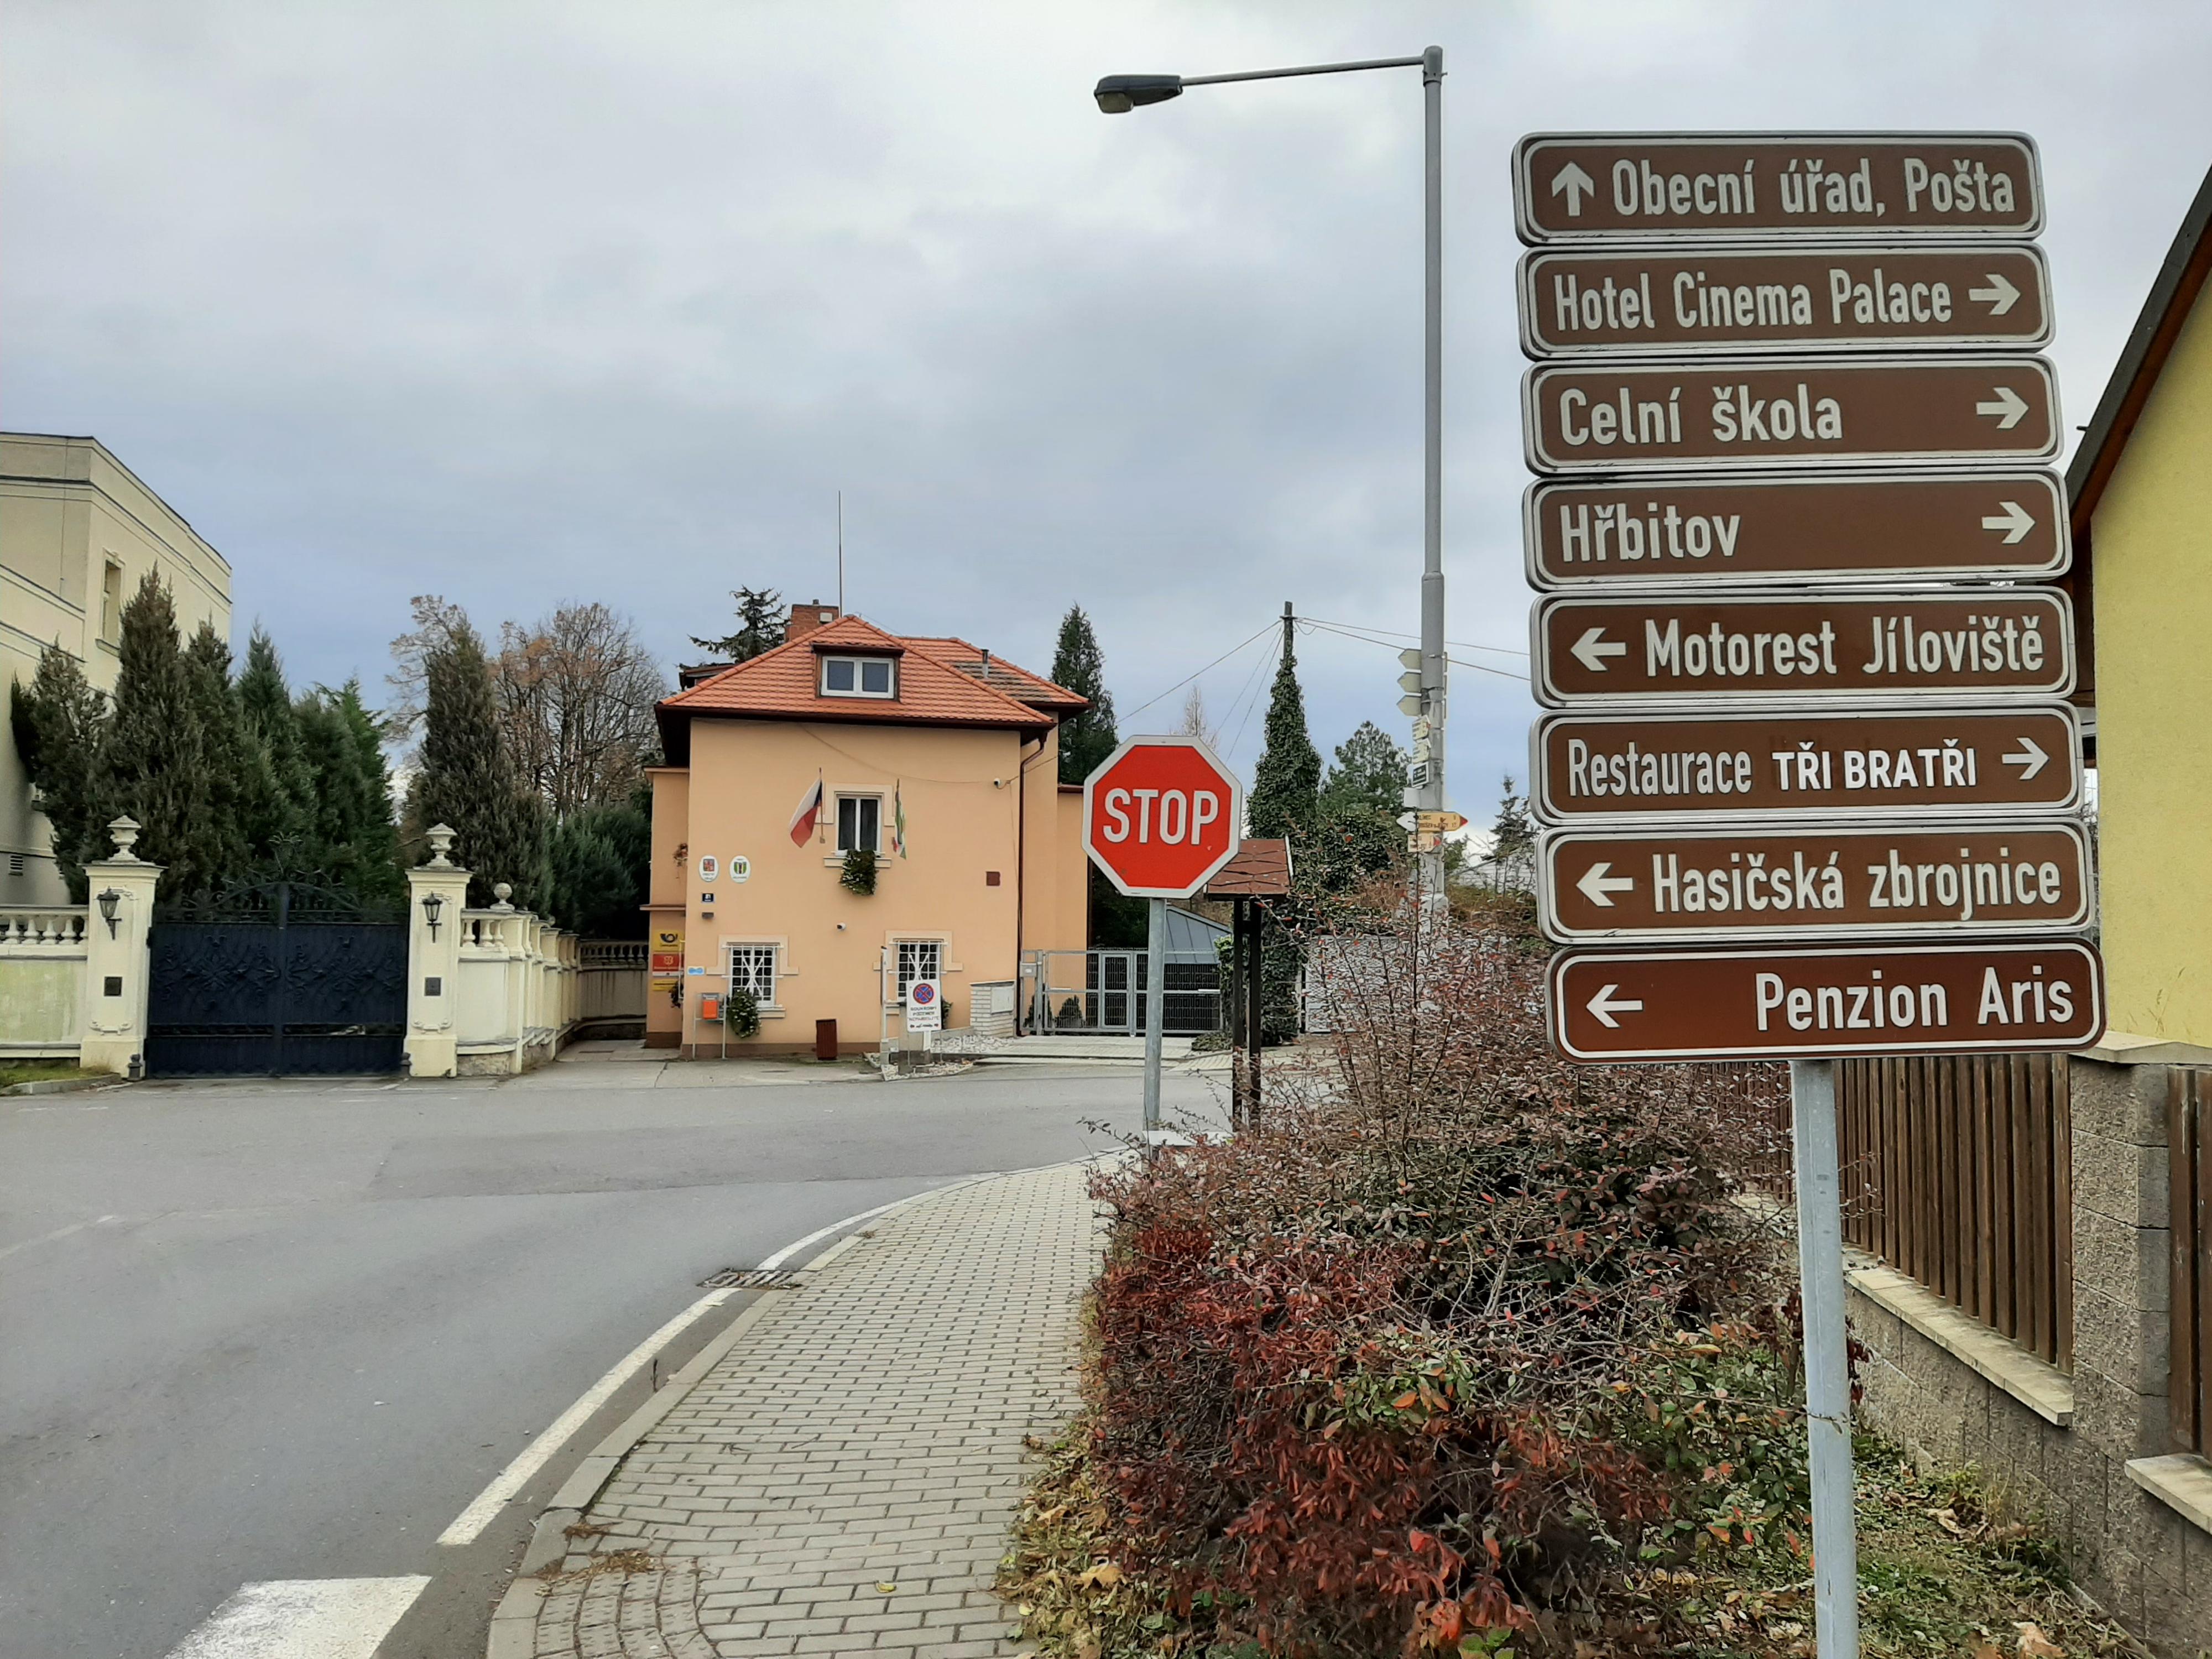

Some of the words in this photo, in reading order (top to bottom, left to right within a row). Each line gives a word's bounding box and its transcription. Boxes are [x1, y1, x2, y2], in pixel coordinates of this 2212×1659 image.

[1612, 159, 1755, 216] Obecní
[1780, 158, 1886, 218] úřad,
[1903, 158, 2015, 213] Pošta
[1553, 272, 1656, 331] Hotel
[1673, 271, 1813, 328] Cinema
[1828, 268, 1952, 325] Palace
[1559, 386, 1682, 446] Celní
[1711, 383, 1843, 442] škola
[1559, 501, 1741, 562] Hřbitov
[1645, 618, 1838, 677] Motorest
[1861, 614, 2044, 674] Jíloviště
[1568, 738, 1752, 797] Restaurace
[1771, 741, 1832, 791] TŘI
[1843, 738, 1976, 789] BRATŘI
[1103, 788, 1219, 846] STOP
[1652, 851, 1845, 913] Hasičská
[1867, 847, 2063, 920] zbrojnice
[1755, 969, 1948, 1031] Penzion
[1977, 964, 2074, 1025] Aris
